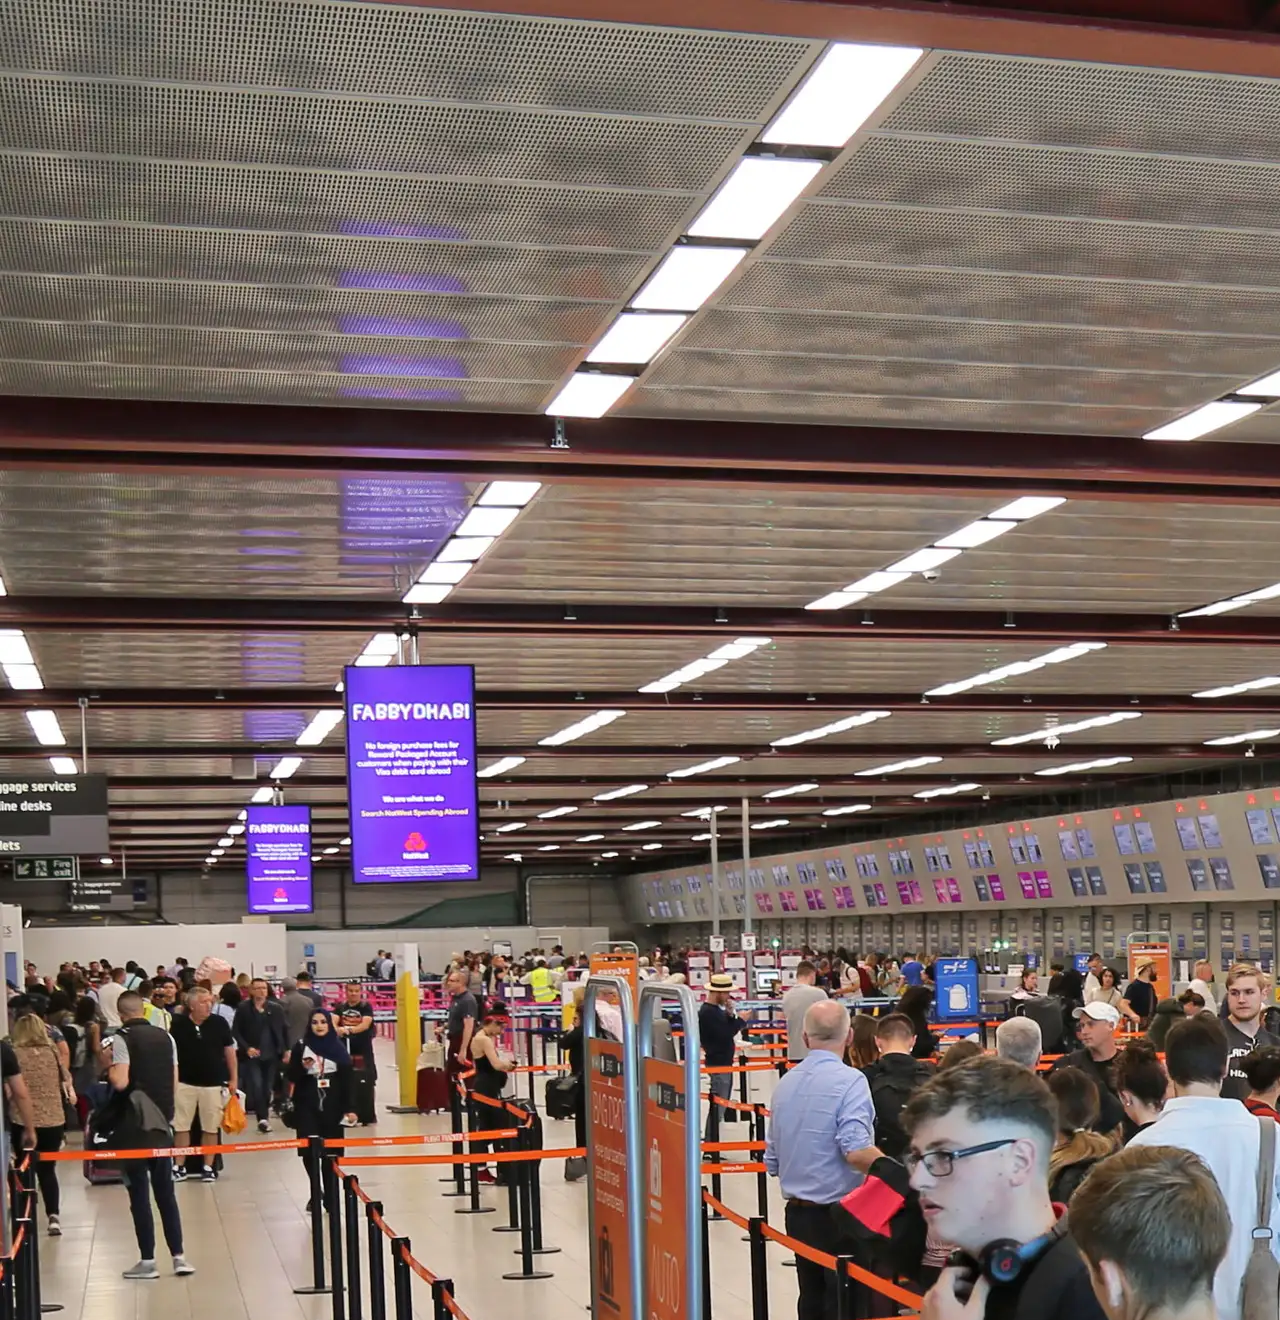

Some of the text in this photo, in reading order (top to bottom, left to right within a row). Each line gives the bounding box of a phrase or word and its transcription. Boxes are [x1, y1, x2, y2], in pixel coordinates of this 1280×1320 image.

[352, 703, 470, 721] FABBYDHABI
[377, 741, 401, 750] foreign
[401, 742, 433, 750] purchase
[433, 741, 448, 749] fees
[448, 741, 459, 749] for
[395, 751, 428, 759] Packaged
[437, 758, 452, 766] with
[452, 758, 469, 766] their
[426, 767, 451, 775] abroad
[31, 781, 77, 792] services
[21, 801, 52, 811] desks
[384, 809, 412, 817] NatWest
[413, 809, 444, 818] Spending
[444, 808, 469, 816] Abroad
[53, 860, 71, 868] Fire
[746, 938, 753, 947] 5
[651, 1244, 680, 1314] AUTO
